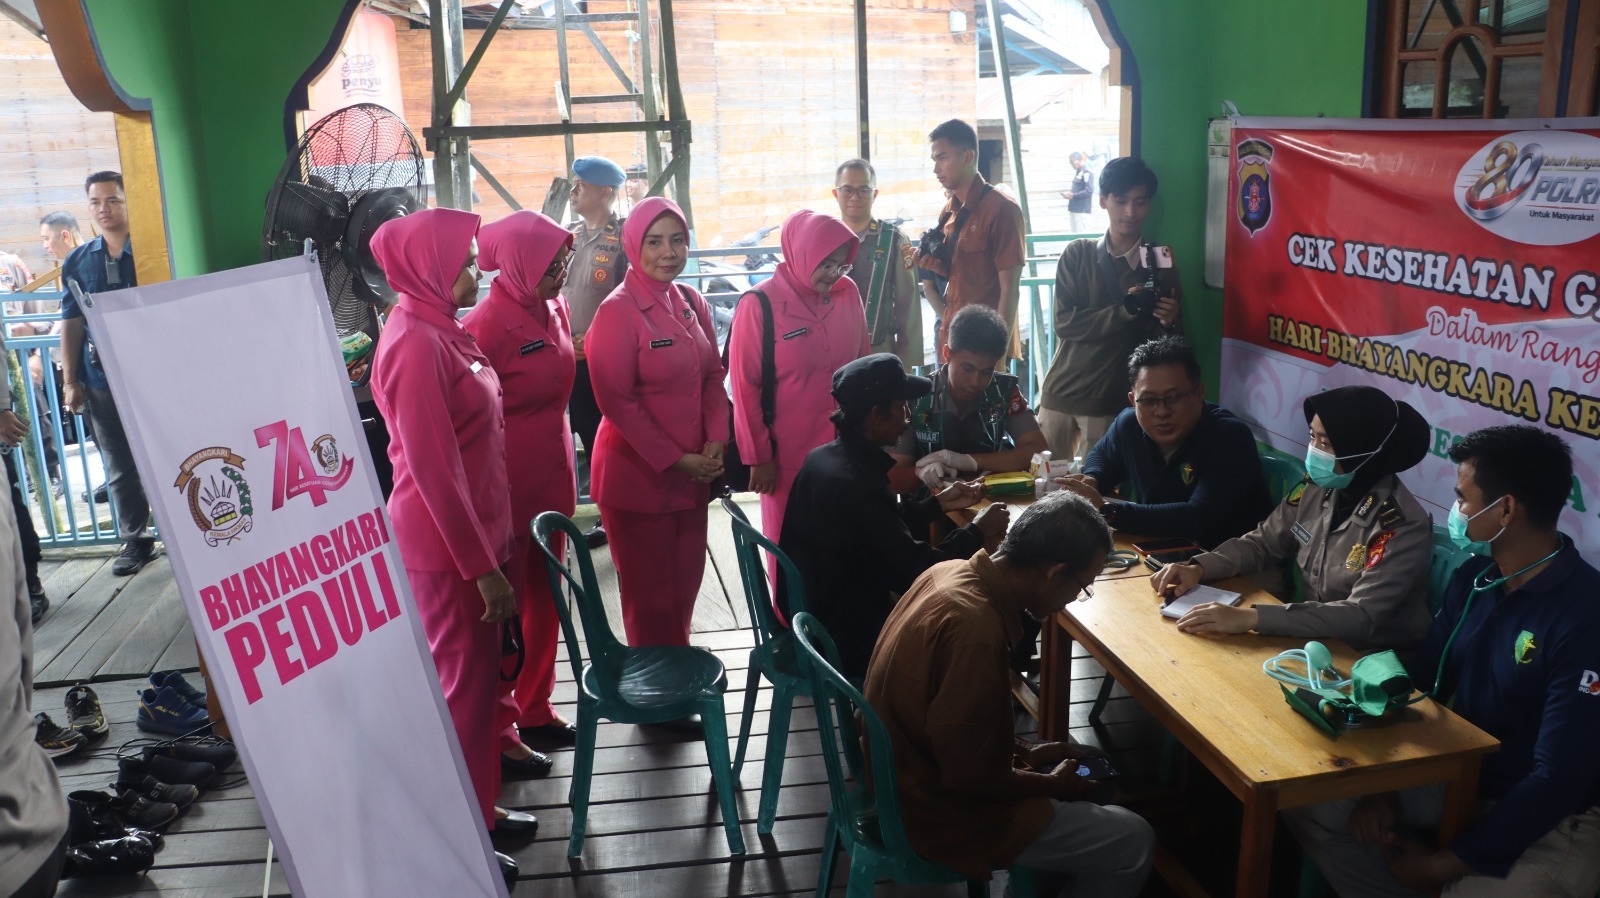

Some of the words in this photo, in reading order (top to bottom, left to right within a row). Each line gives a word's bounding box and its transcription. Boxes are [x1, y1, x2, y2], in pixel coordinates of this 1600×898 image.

[341, 77, 382, 90] penyu
[1529, 209, 1550, 219] Untuk
[1552, 211, 1594, 222] Masyarakat
[594, 244, 619, 253] POLRI
[1287, 234, 1337, 272] CEK
[1343, 242, 1555, 309] KESEHATAN
[1428, 310, 1518, 353] Dalam
[1268, 315, 1322, 353] HARI
[1327, 331, 1539, 419] BHAYANGKARA
[183, 448, 229, 471] BHAYANGKARI
[199, 507, 390, 631] BHAYANGKARI
[223, 551, 401, 706] PEDULI
